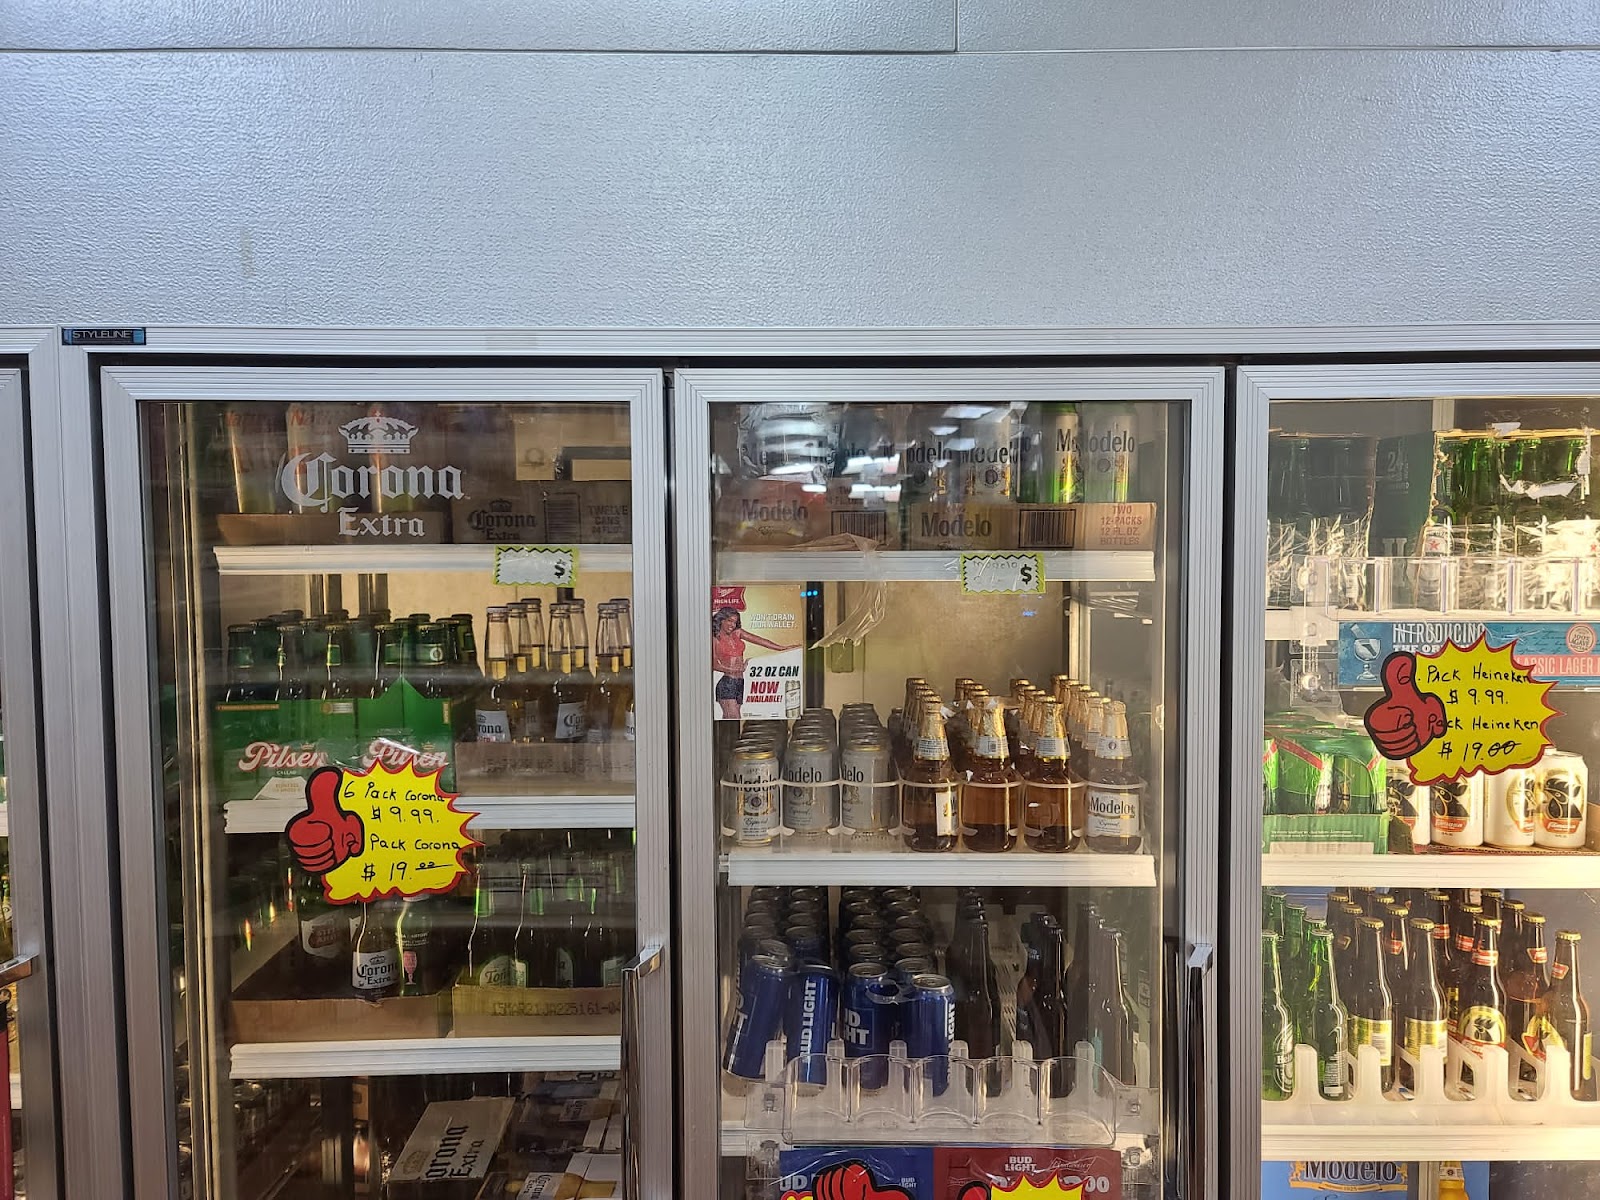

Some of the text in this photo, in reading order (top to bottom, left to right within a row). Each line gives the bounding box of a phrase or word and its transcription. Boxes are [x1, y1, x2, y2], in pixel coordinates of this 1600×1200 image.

[72, 330, 132, 339] STYLELINE
[275, 452, 465, 513] Corona
[743, 499, 809, 522] Modelo
[1112, 505, 1132, 514] TWO
[337, 506, 426, 537] Extra
[467, 509, 537, 532] Corona
[921, 512, 992, 537] Modelo
[1101, 516, 1143, 525] 12-PACKS
[1101, 527, 1111, 535] 12
[1101, 537, 1140, 545] BOTTLES
[1021, 564, 1032, 584] $
[773, 613, 795, 621] DRAIN
[750, 665, 799, 677] 32 OZ CAN
[1473, 662, 1530, 684] Heineken
[1559, 656, 1594, 675] LAGER
[750, 681, 780, 694] NOW
[746, 695, 783, 703] AVAILABLE!
[478, 722, 503, 734] rona
[1428, 713, 1463, 732] Pack
[1472, 715, 1539, 731] Heineken
[239, 741, 327, 771] Pilsen
[1438, 741, 1453, 760] $
[786, 767, 822, 783] odelo
[344, 780, 445, 802] 6 Pack Corona
[1090, 797, 1130, 814] Modelo
[342, 832, 461, 853] 12 Pack Corona
[361, 863, 376, 882] $
[802, 979, 816, 1027] LIGHT
[425, 1124, 468, 1180] orona
[449, 1138, 485, 1178] Extra
[1005, 1163, 1036, 1172] LIGHT
[1305, 1161, 1397, 1181] Modelo
[779, 1175, 808, 1191] UD
